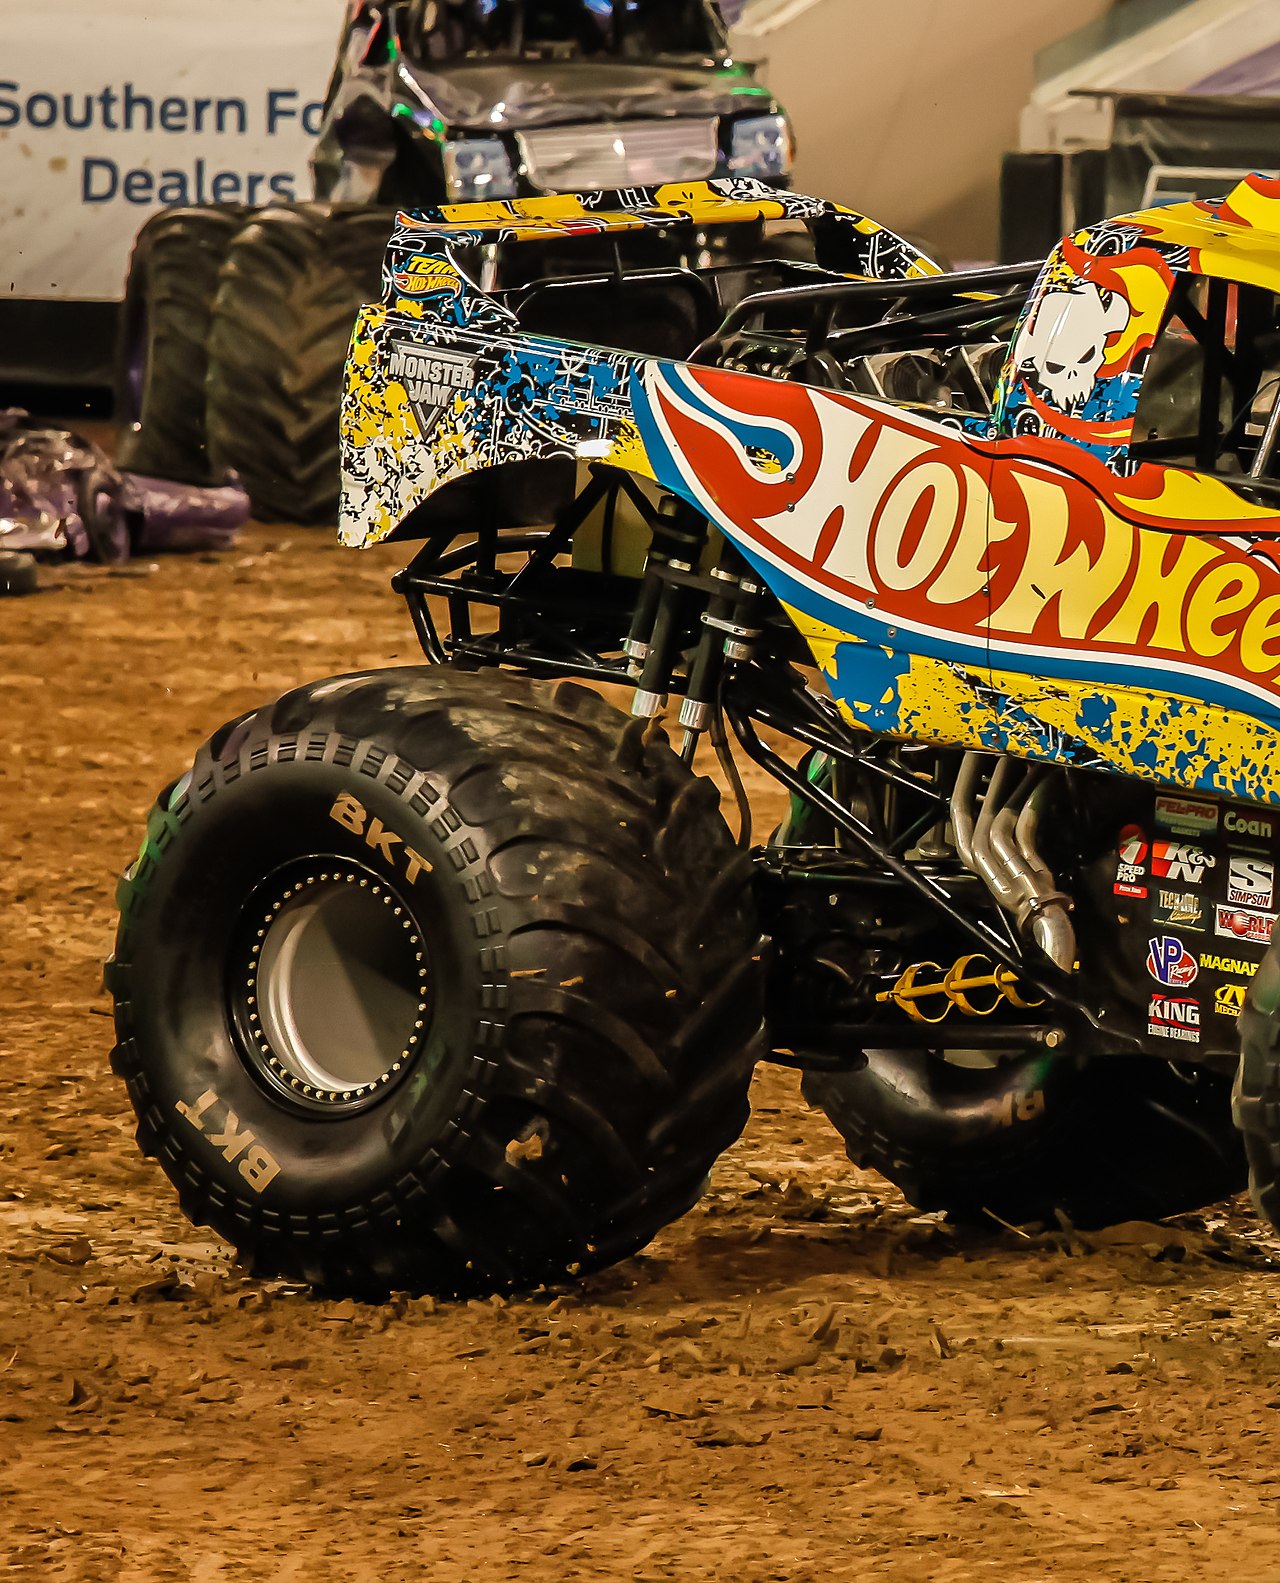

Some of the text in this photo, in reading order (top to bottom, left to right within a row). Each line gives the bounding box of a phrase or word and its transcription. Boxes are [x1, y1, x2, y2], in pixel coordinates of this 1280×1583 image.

[0, 81, 327, 136] Southern Fo
[81, 155, 297, 206] Dealers
[406, 254, 460, 278] TEAM
[388, 352, 475, 390] MONSTER
[409, 379, 452, 408] JAM
[327, 792, 434, 886] BKT
[1223, 810, 1272, 839] Coan
[1115, 872, 1137, 883] PRO
[1117, 863, 1146, 876] SPEED
[1229, 889, 1271, 907] SIMPSON
[1199, 953, 1260, 977] MAGNAF
[1148, 998, 1202, 1025] KING
[174, 1087, 284, 1194] BKT
